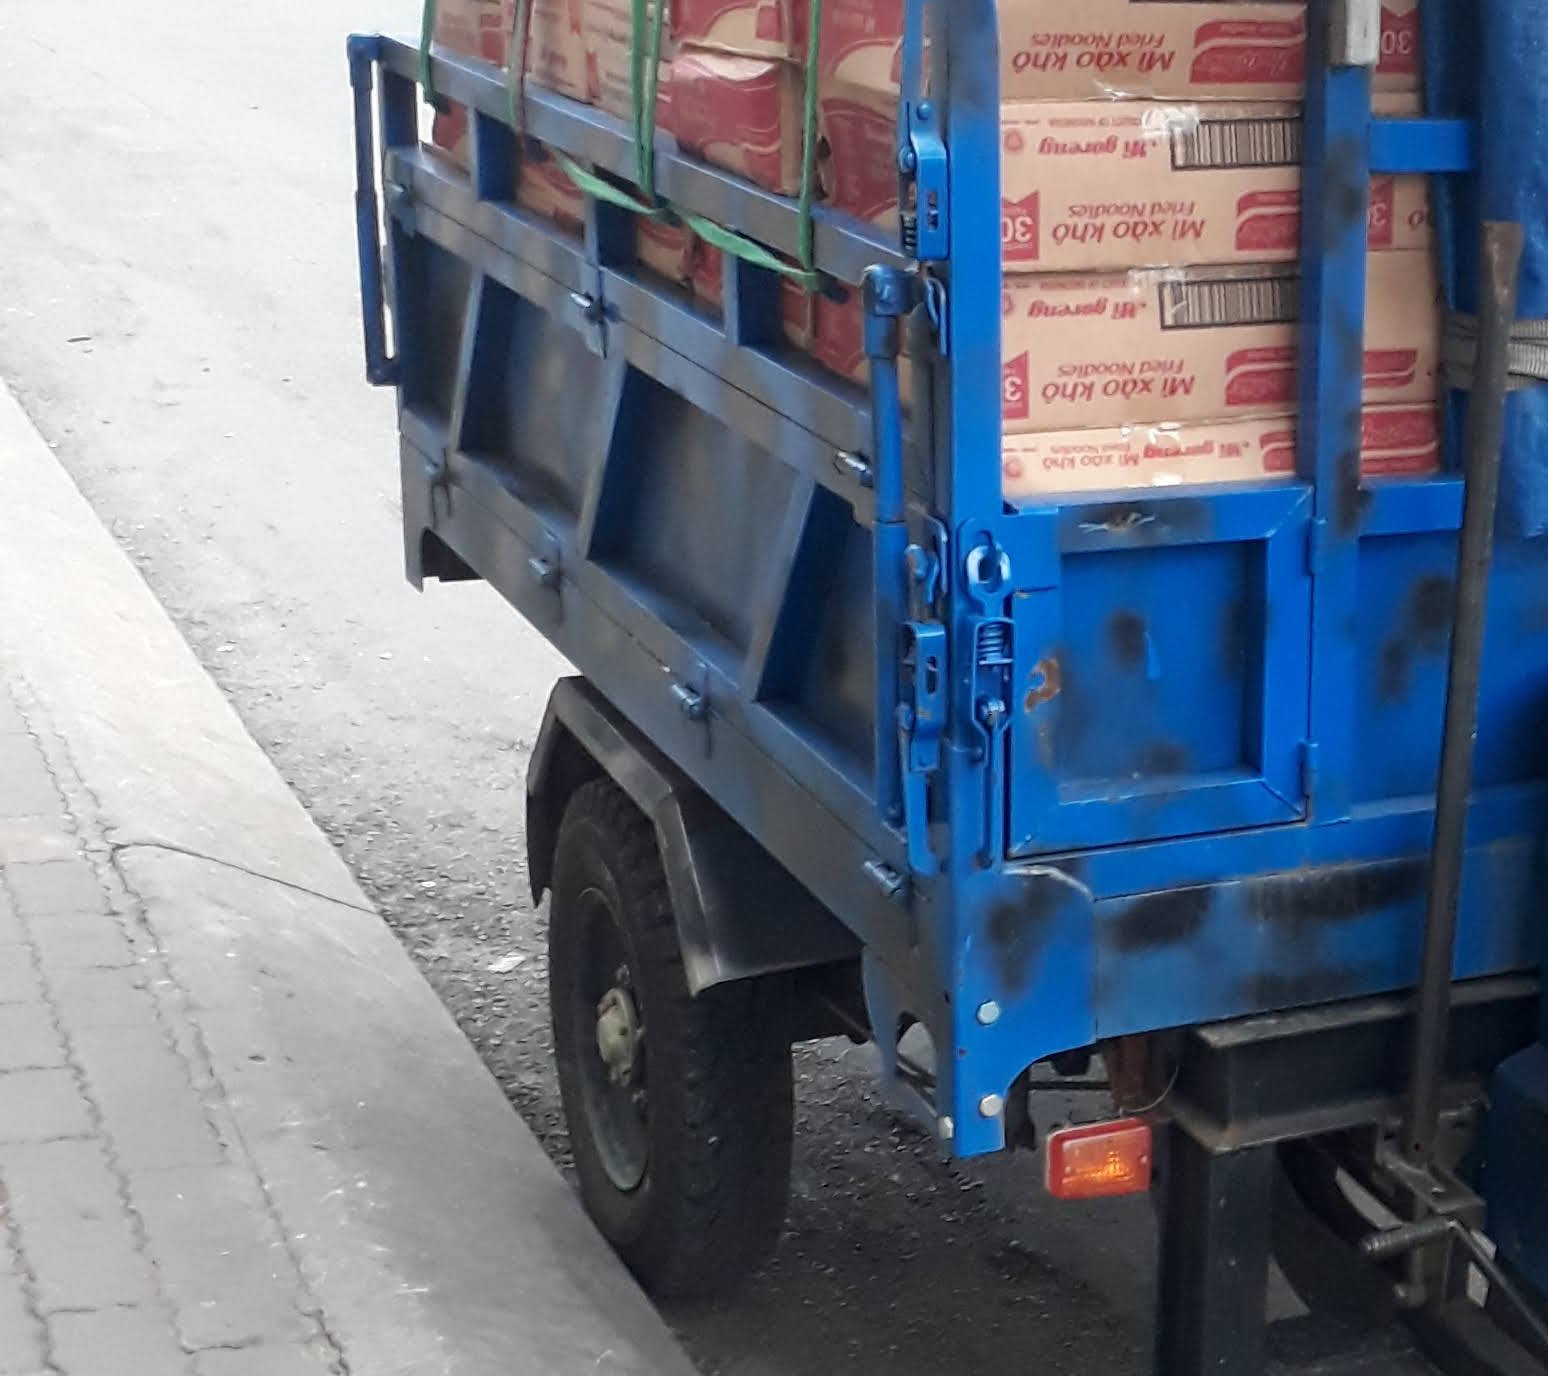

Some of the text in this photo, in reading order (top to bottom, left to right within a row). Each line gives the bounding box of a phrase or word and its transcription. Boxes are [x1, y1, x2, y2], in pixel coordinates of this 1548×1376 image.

[1031, 32, 1165, 49] Fried Noodles
[1381, 29, 1413, 54] 30
[1012, 51, 1068, 74] khô
[1077, 51, 1130, 72] xào
[1038, 135, 1118, 158] goreng
[1068, 201, 1195, 218] Fried Noodles
[1002, 215, 1033, 242] 30
[1051, 222, 1105, 246] khô
[1112, 220, 1163, 243] xào
[1028, 298, 1108, 318] goreng
[1058, 359, 1185, 378] Fried Noodles
[1041, 377, 1095, 402] khô
[1102, 377, 1154, 400] xào
